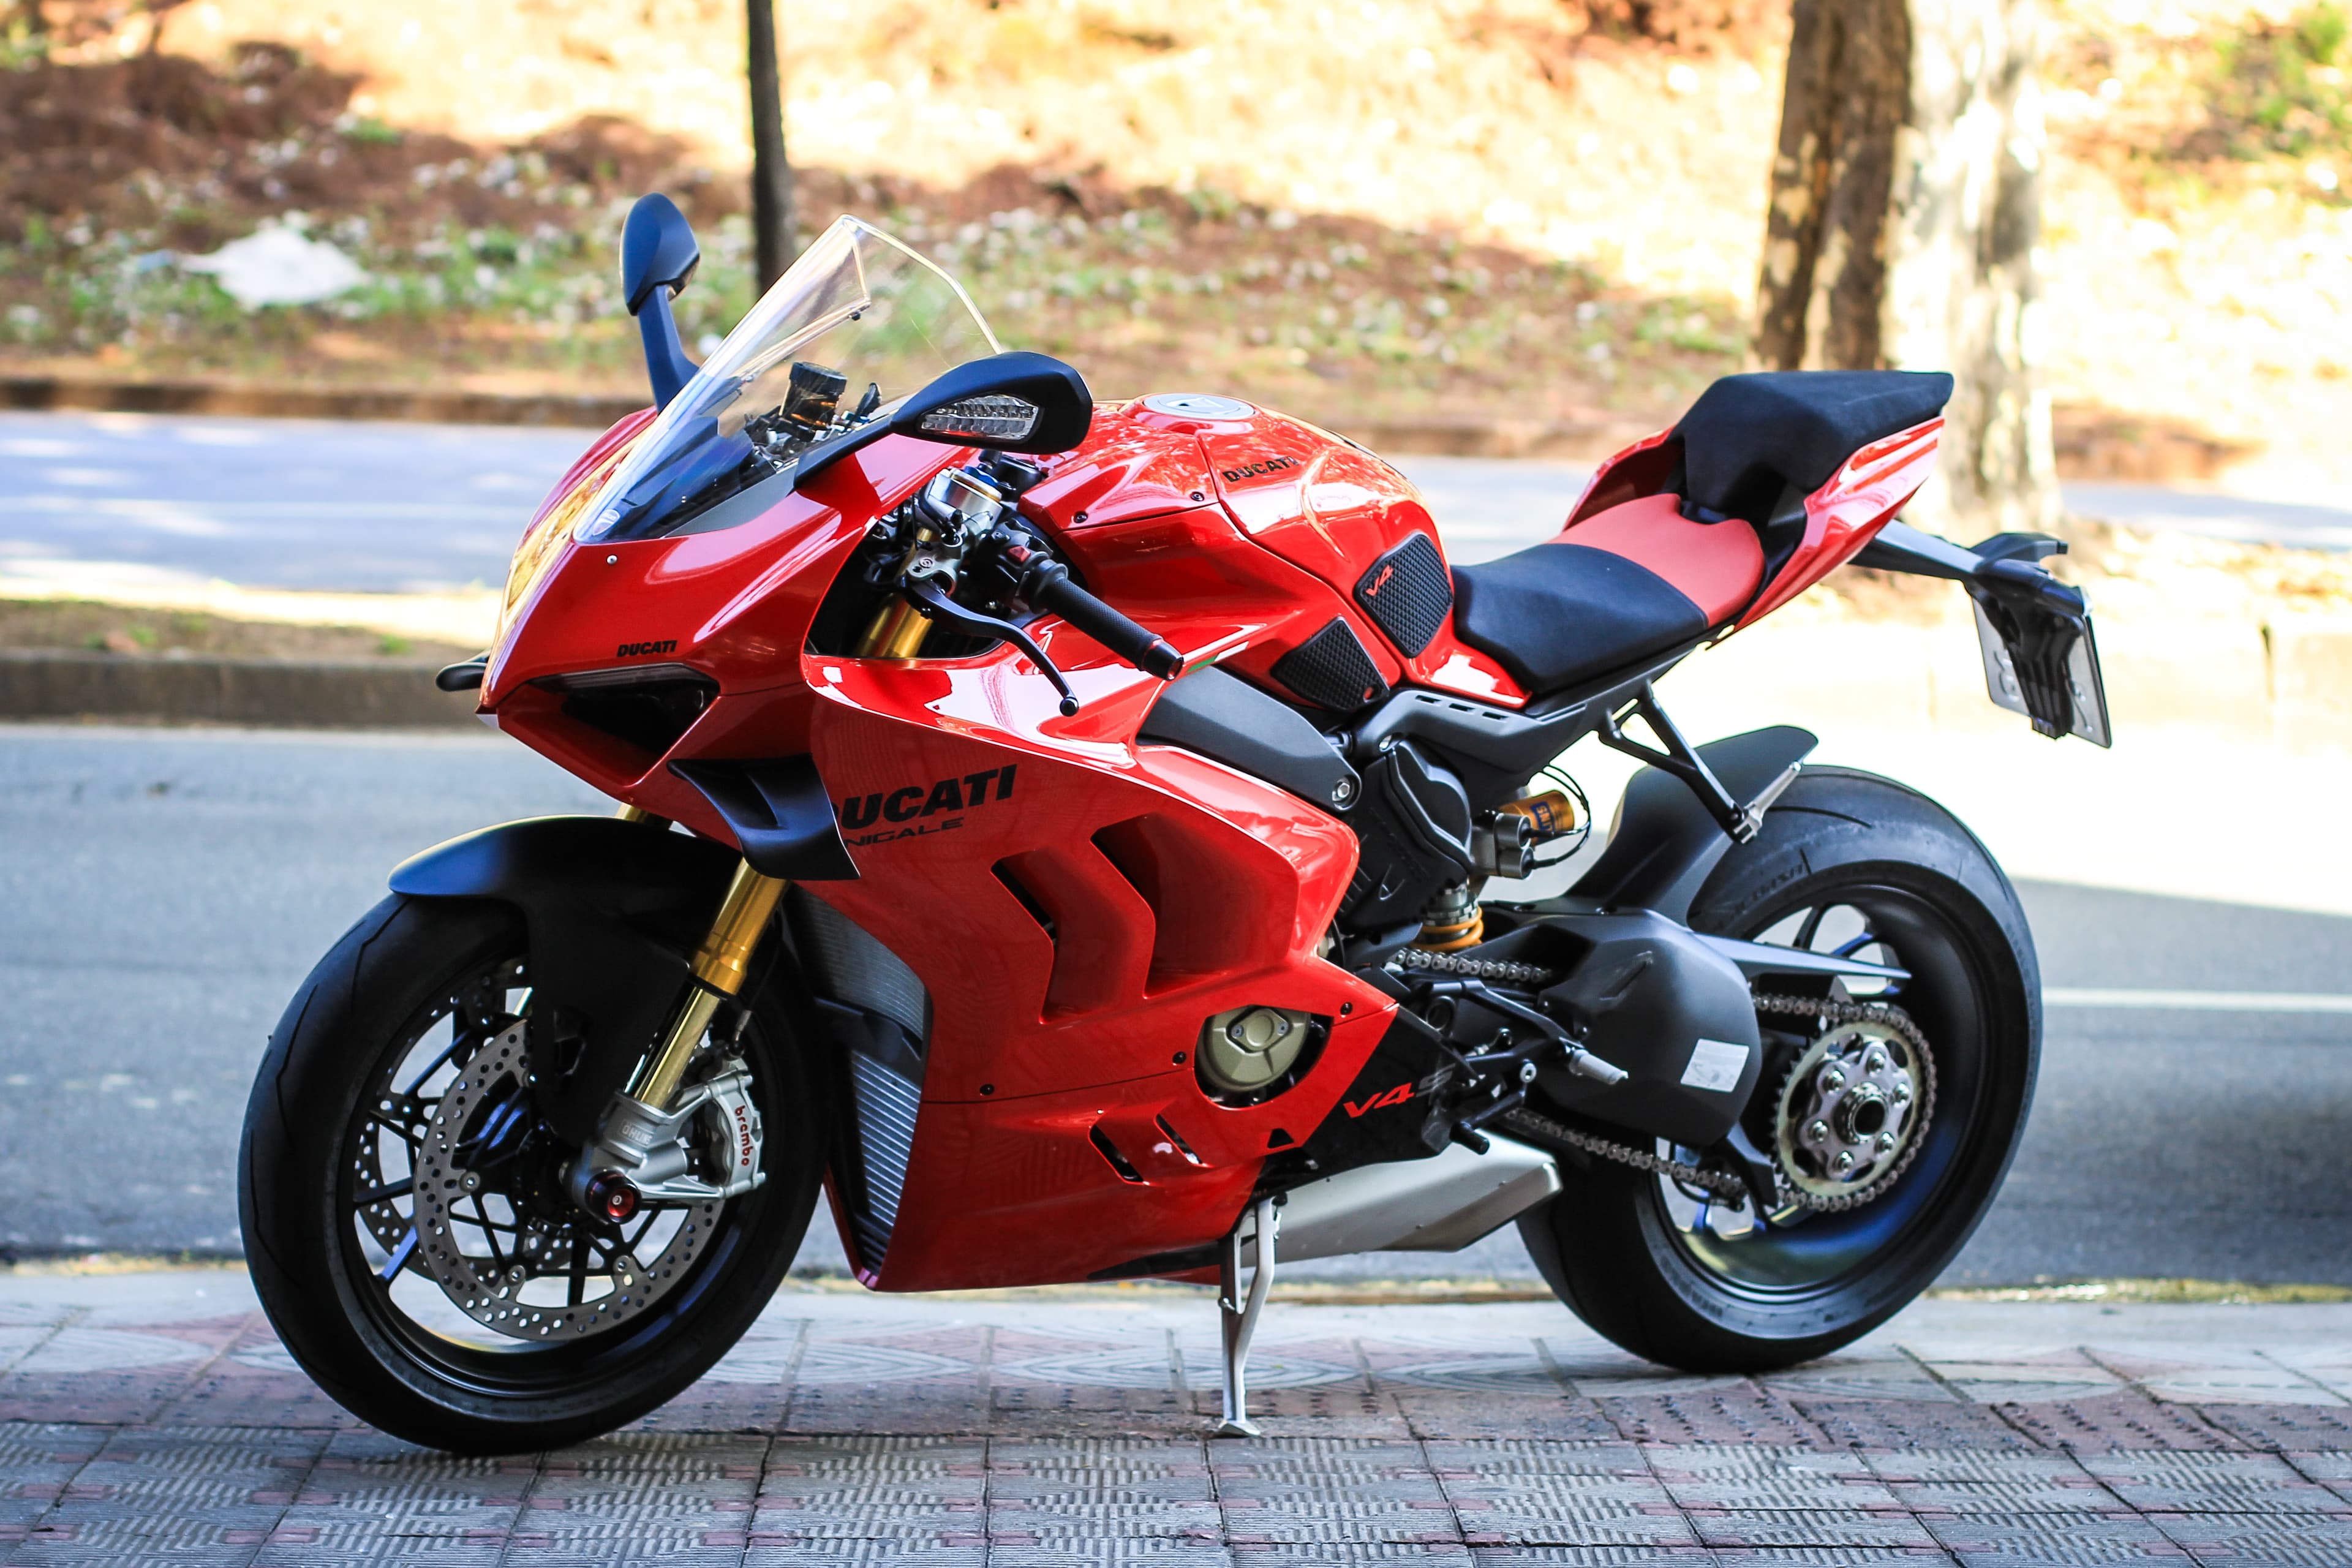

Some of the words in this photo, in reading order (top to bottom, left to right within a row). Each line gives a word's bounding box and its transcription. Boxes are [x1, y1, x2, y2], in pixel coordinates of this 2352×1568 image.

[1223, 455, 1300, 483] DUCATI
[1365, 565, 1393, 597] V4
[617, 639, 677, 657] DUCATI
[831, 764, 1017, 829] UCATI
[843, 816, 965, 846] NIGALE
[734, 1105, 753, 1166] brembo
